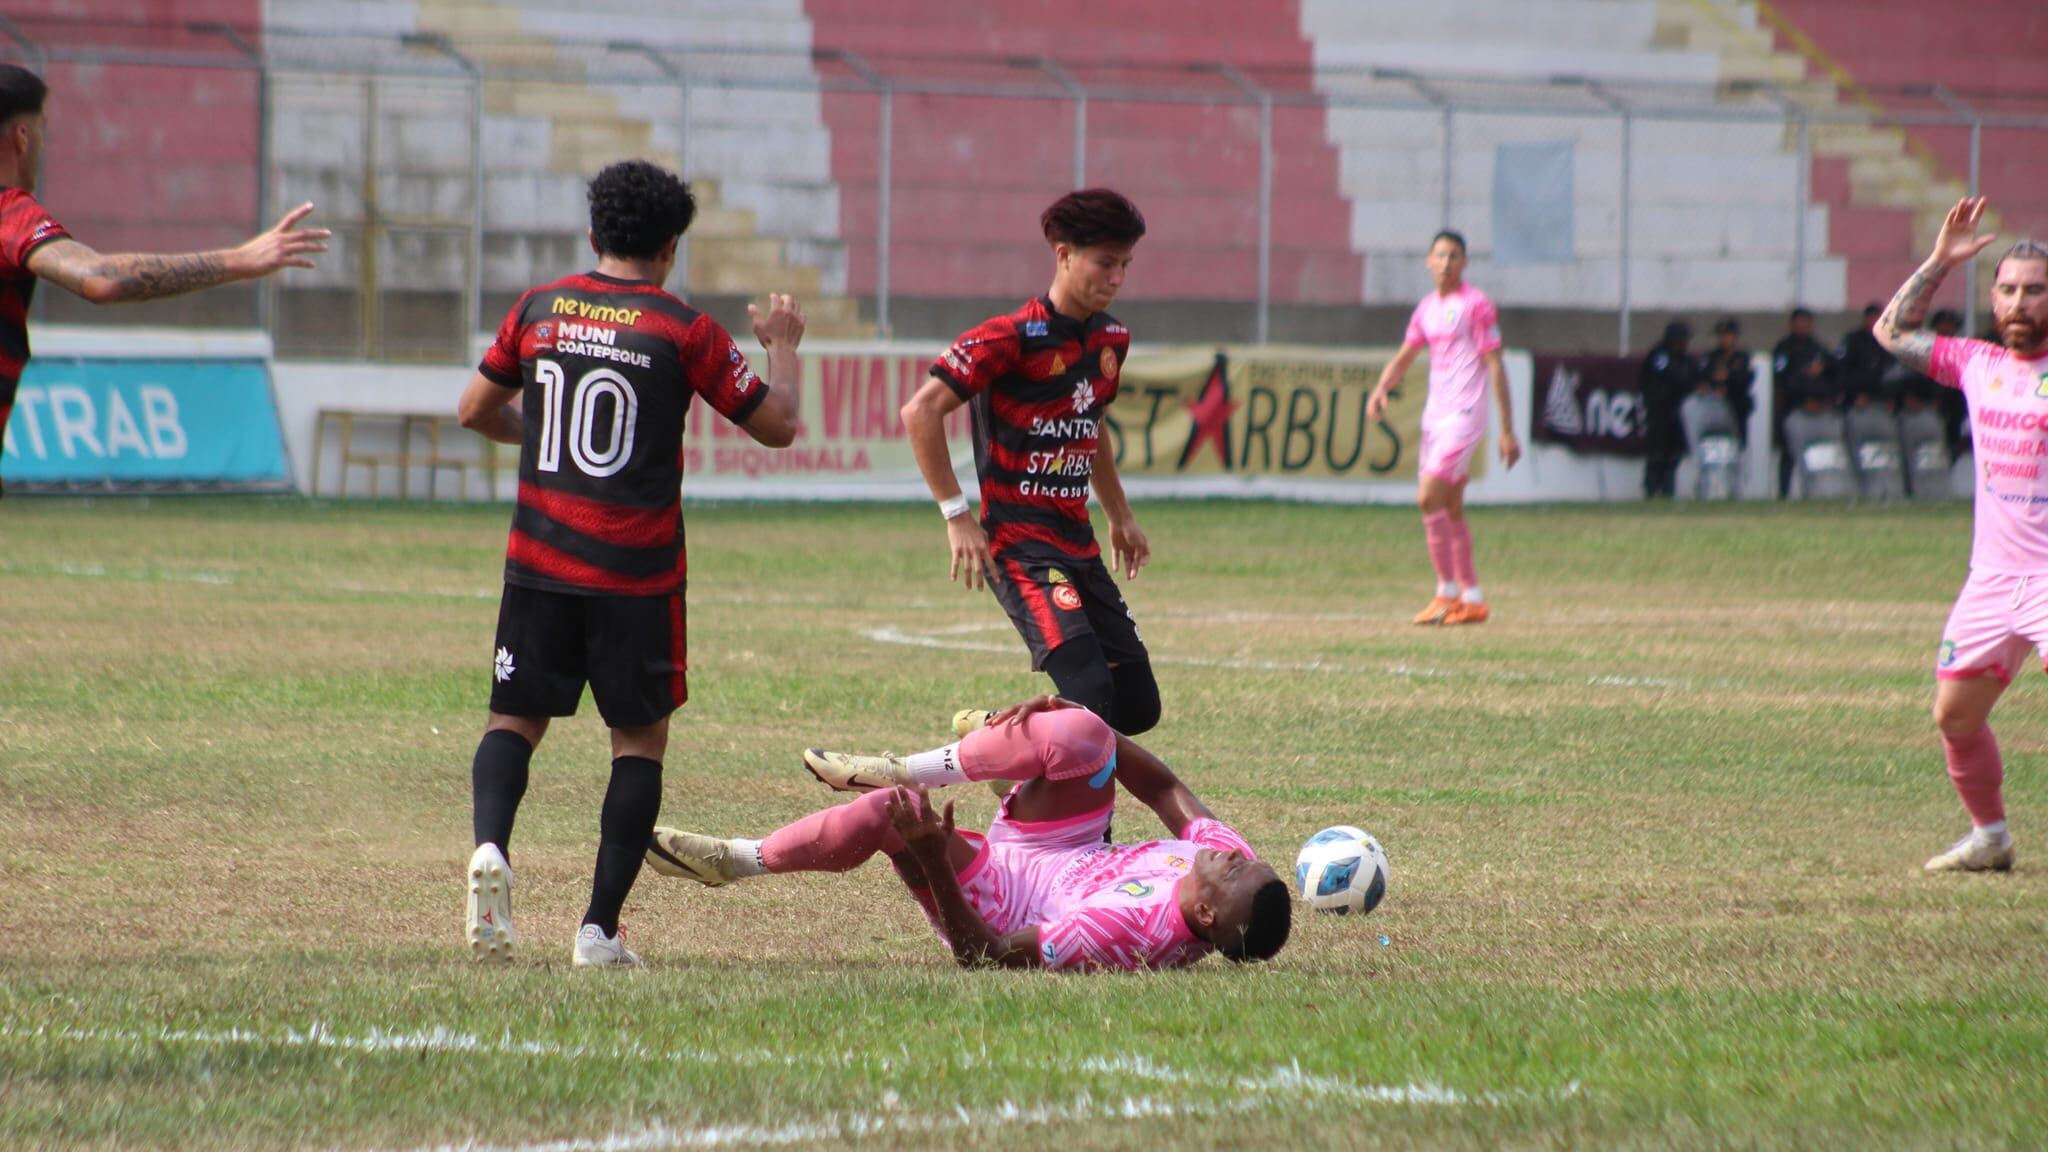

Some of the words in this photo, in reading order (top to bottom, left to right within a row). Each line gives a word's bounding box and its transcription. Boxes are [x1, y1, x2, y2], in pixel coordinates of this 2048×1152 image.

[552, 297, 642, 326] nevimar
[558, 322, 616, 346] MUNI
[556, 340, 651, 368] COATEPEQUE
[535, 359, 639, 478] 10
[1028, 416, 1100, 439] BANTRA
